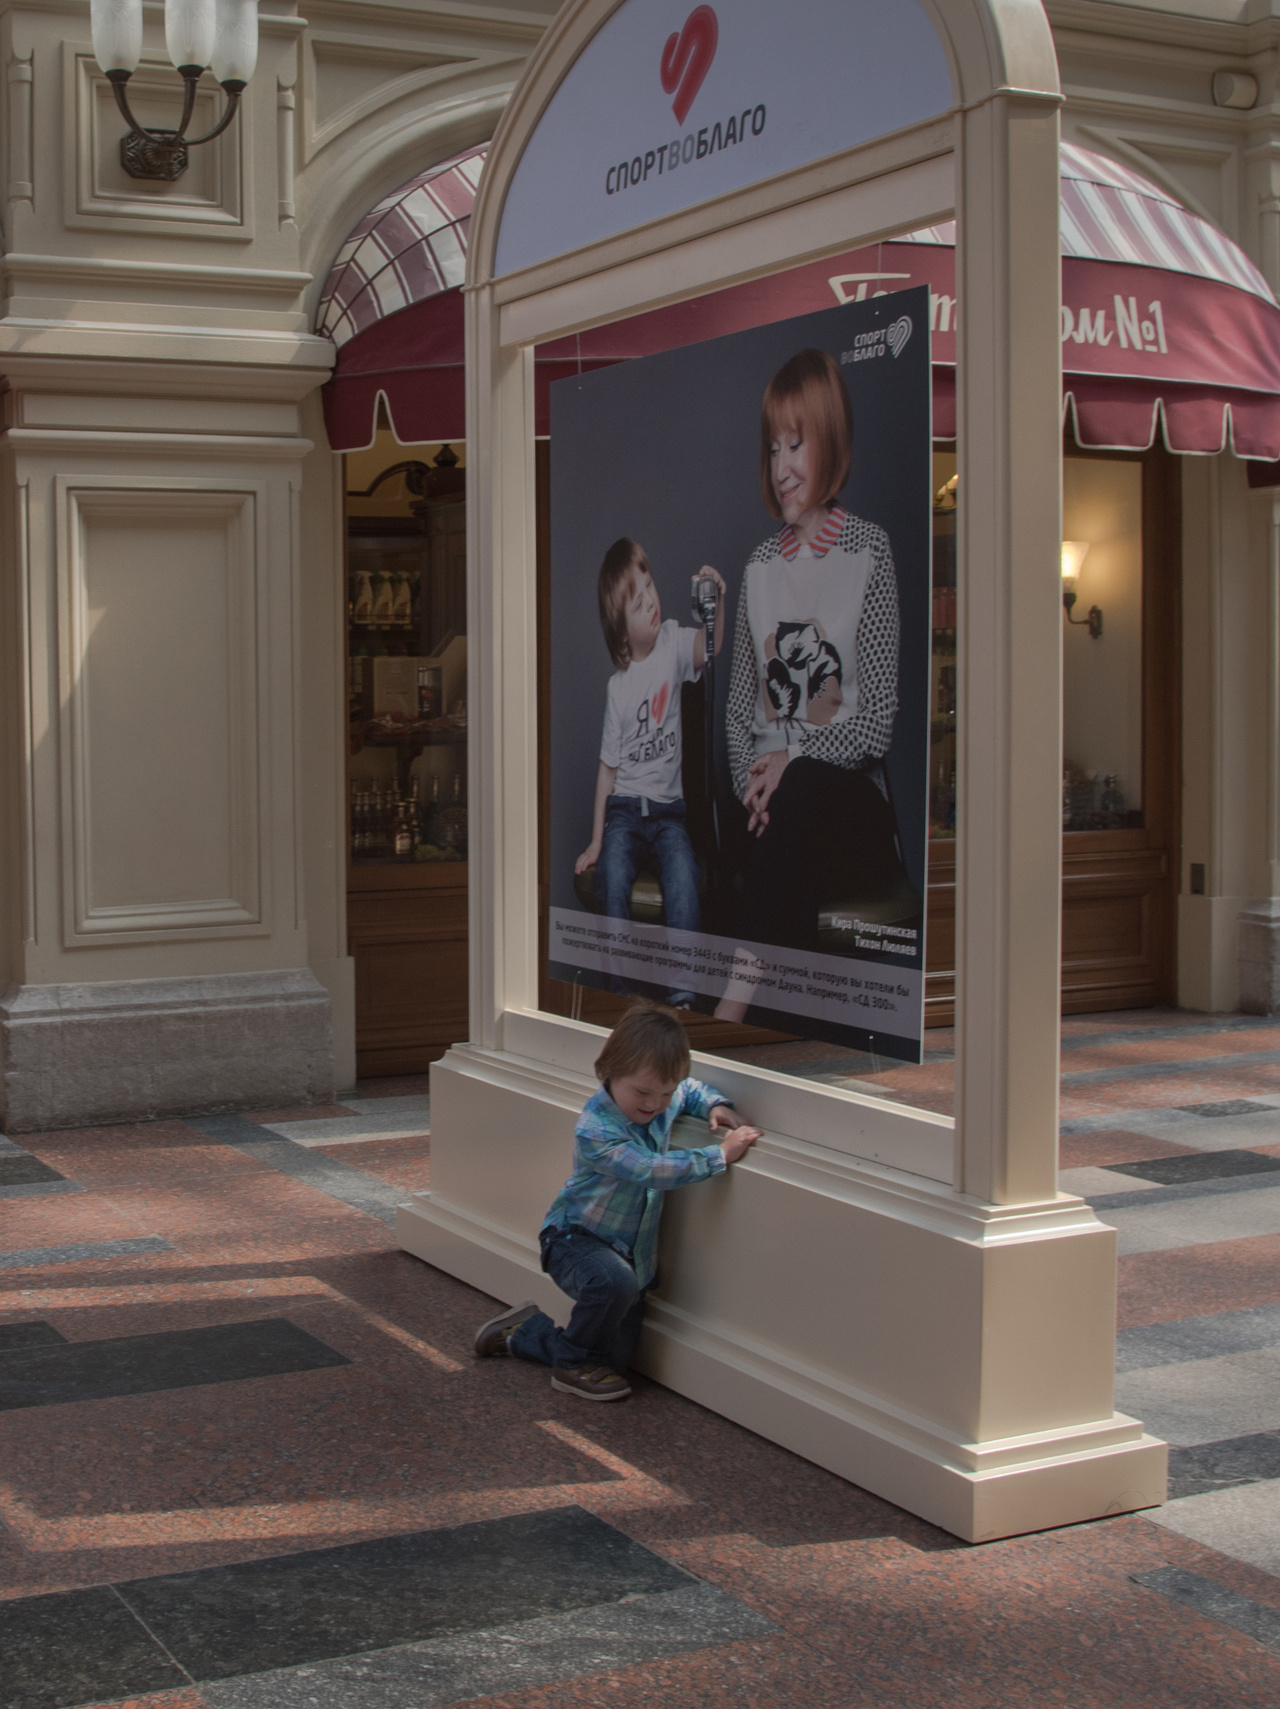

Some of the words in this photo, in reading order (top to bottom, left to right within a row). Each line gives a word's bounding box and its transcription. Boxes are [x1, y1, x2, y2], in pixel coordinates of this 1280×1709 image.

[605, 103, 767, 196] СПОРТВОБЛАГО
[854, 328, 887, 347] СПОРТ
[831, 916, 853, 931] Кира
[854, 935, 882, 951] Тихон
[671, 945, 692, 957] номер
[813, 970, 848, 987] которую
[850, 977, 862, 988] вы
[863, 980, 895, 995] хотели
[896, 984, 910, 997] бы
